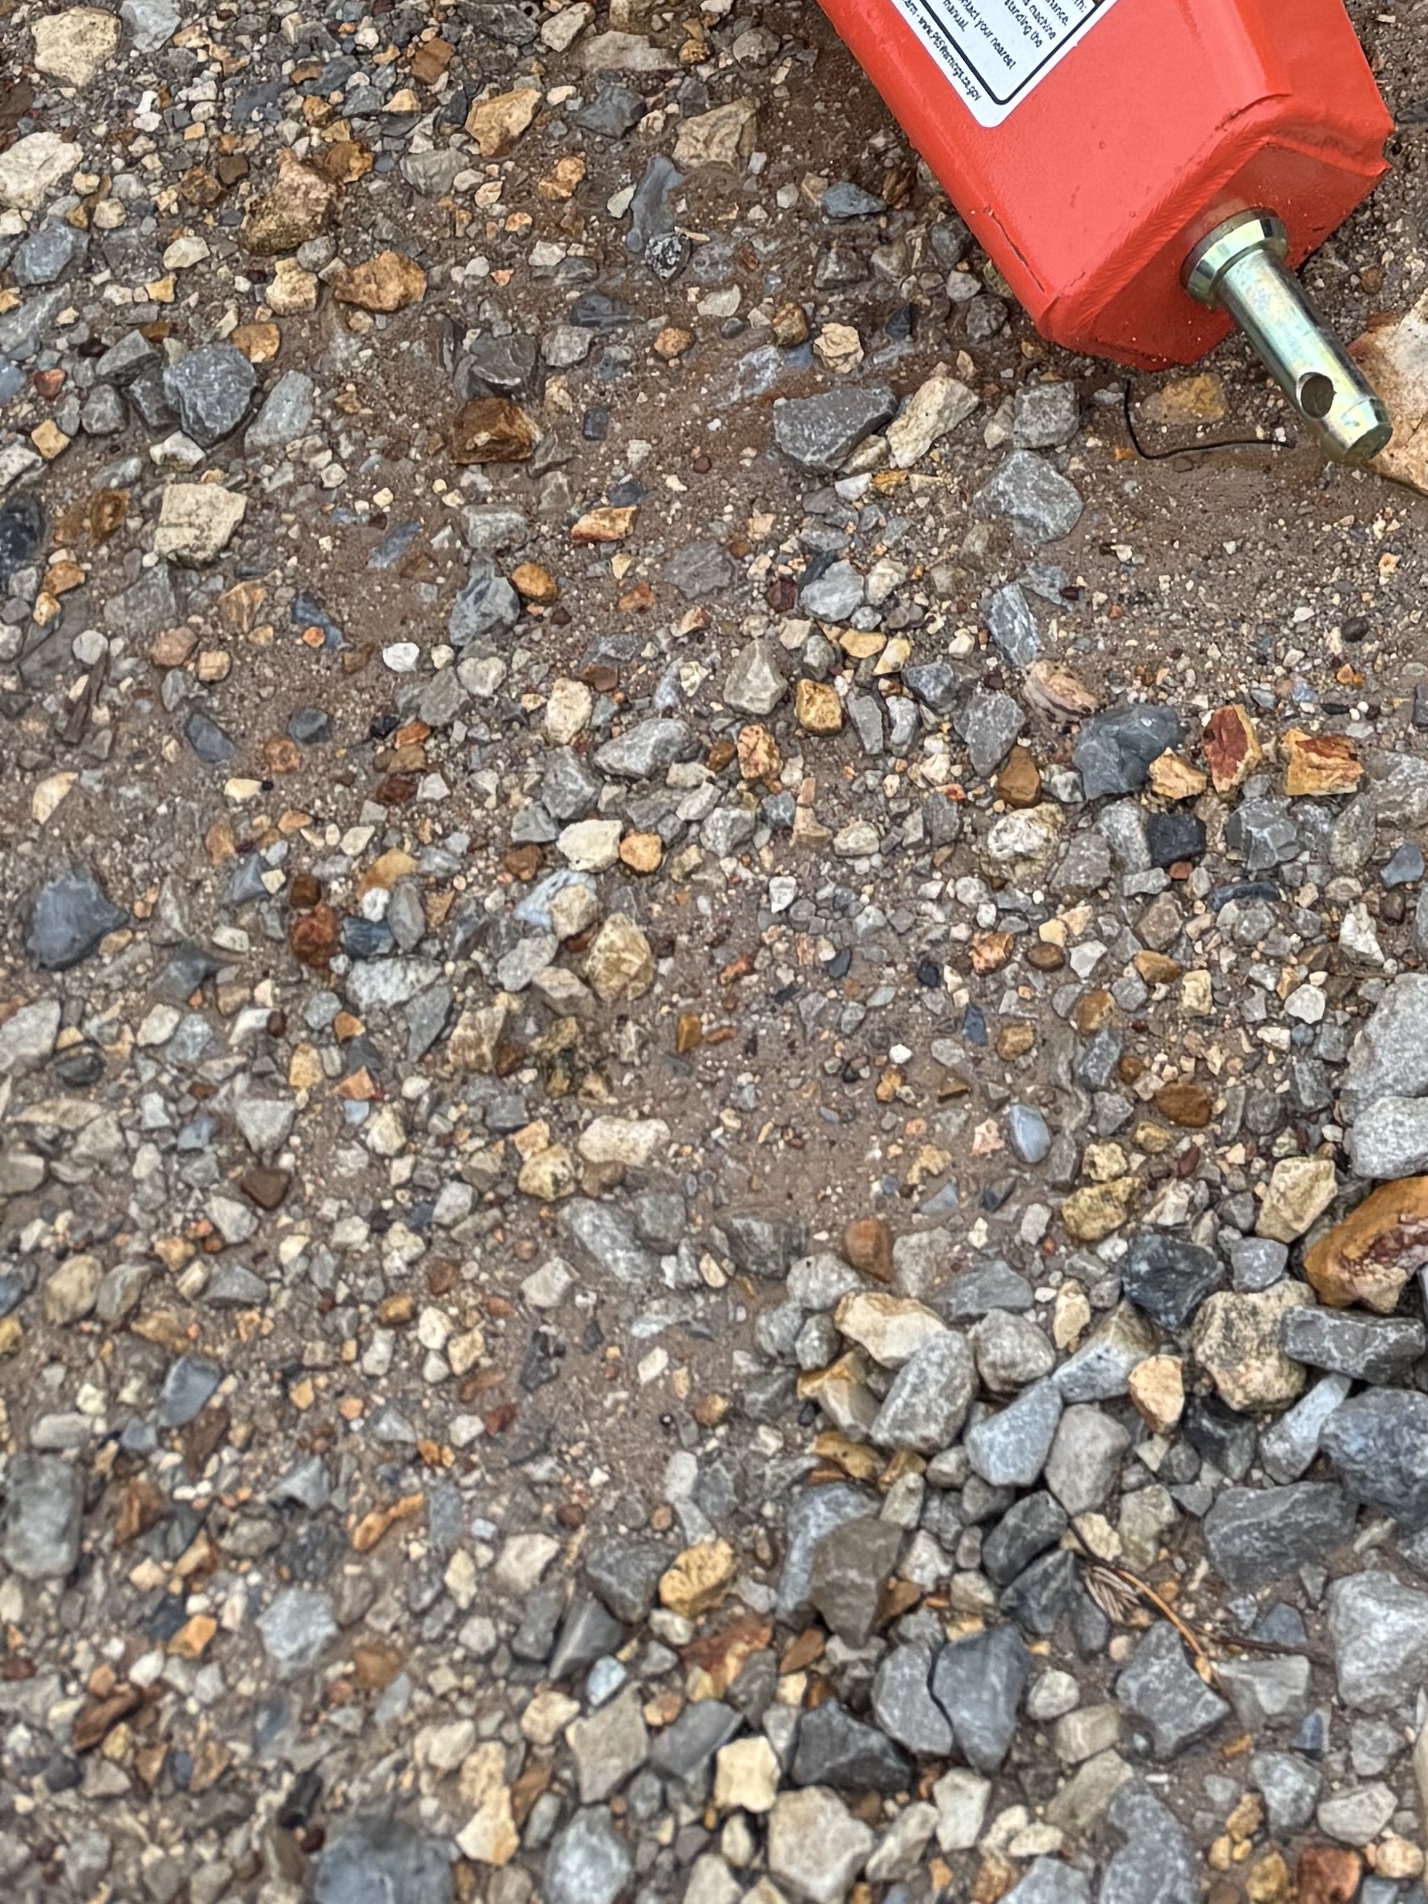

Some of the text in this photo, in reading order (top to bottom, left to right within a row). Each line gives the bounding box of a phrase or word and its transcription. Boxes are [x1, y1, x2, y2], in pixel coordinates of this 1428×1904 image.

[1027, 1, 1059, 41] machine
[1028, 29, 1045, 49] the
[973, 17, 994, 42] your
[989, 34, 1017, 70] nearest
